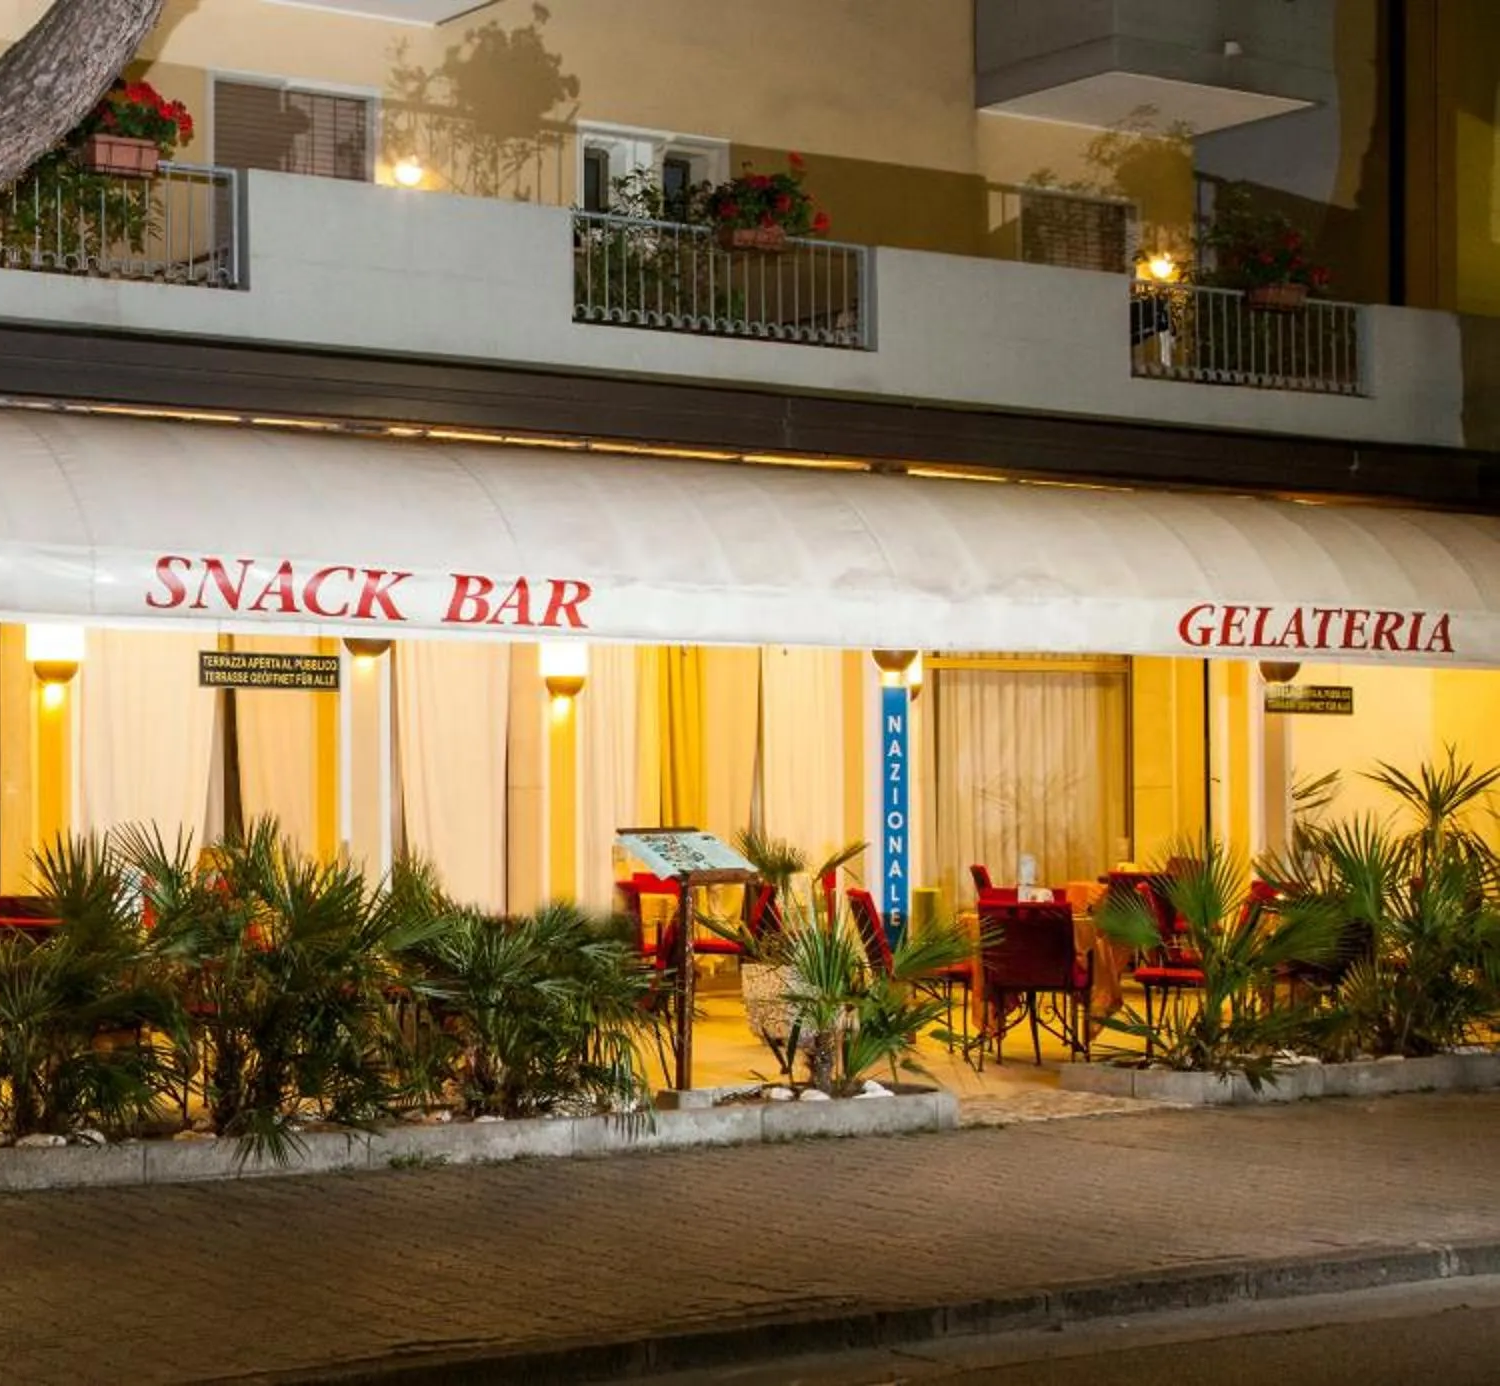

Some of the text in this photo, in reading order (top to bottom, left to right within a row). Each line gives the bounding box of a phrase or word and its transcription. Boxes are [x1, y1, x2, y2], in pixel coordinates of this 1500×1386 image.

[146, 555, 593, 630] SNACK BAR
[1177, 603, 1455, 653] GELATERIA
[202, 655, 337, 671] TERRAZZA APERTA AL PUBBLICO
[204, 671, 249, 683] TERRASSE
[887, 715, 904, 926] NAZIONALE
